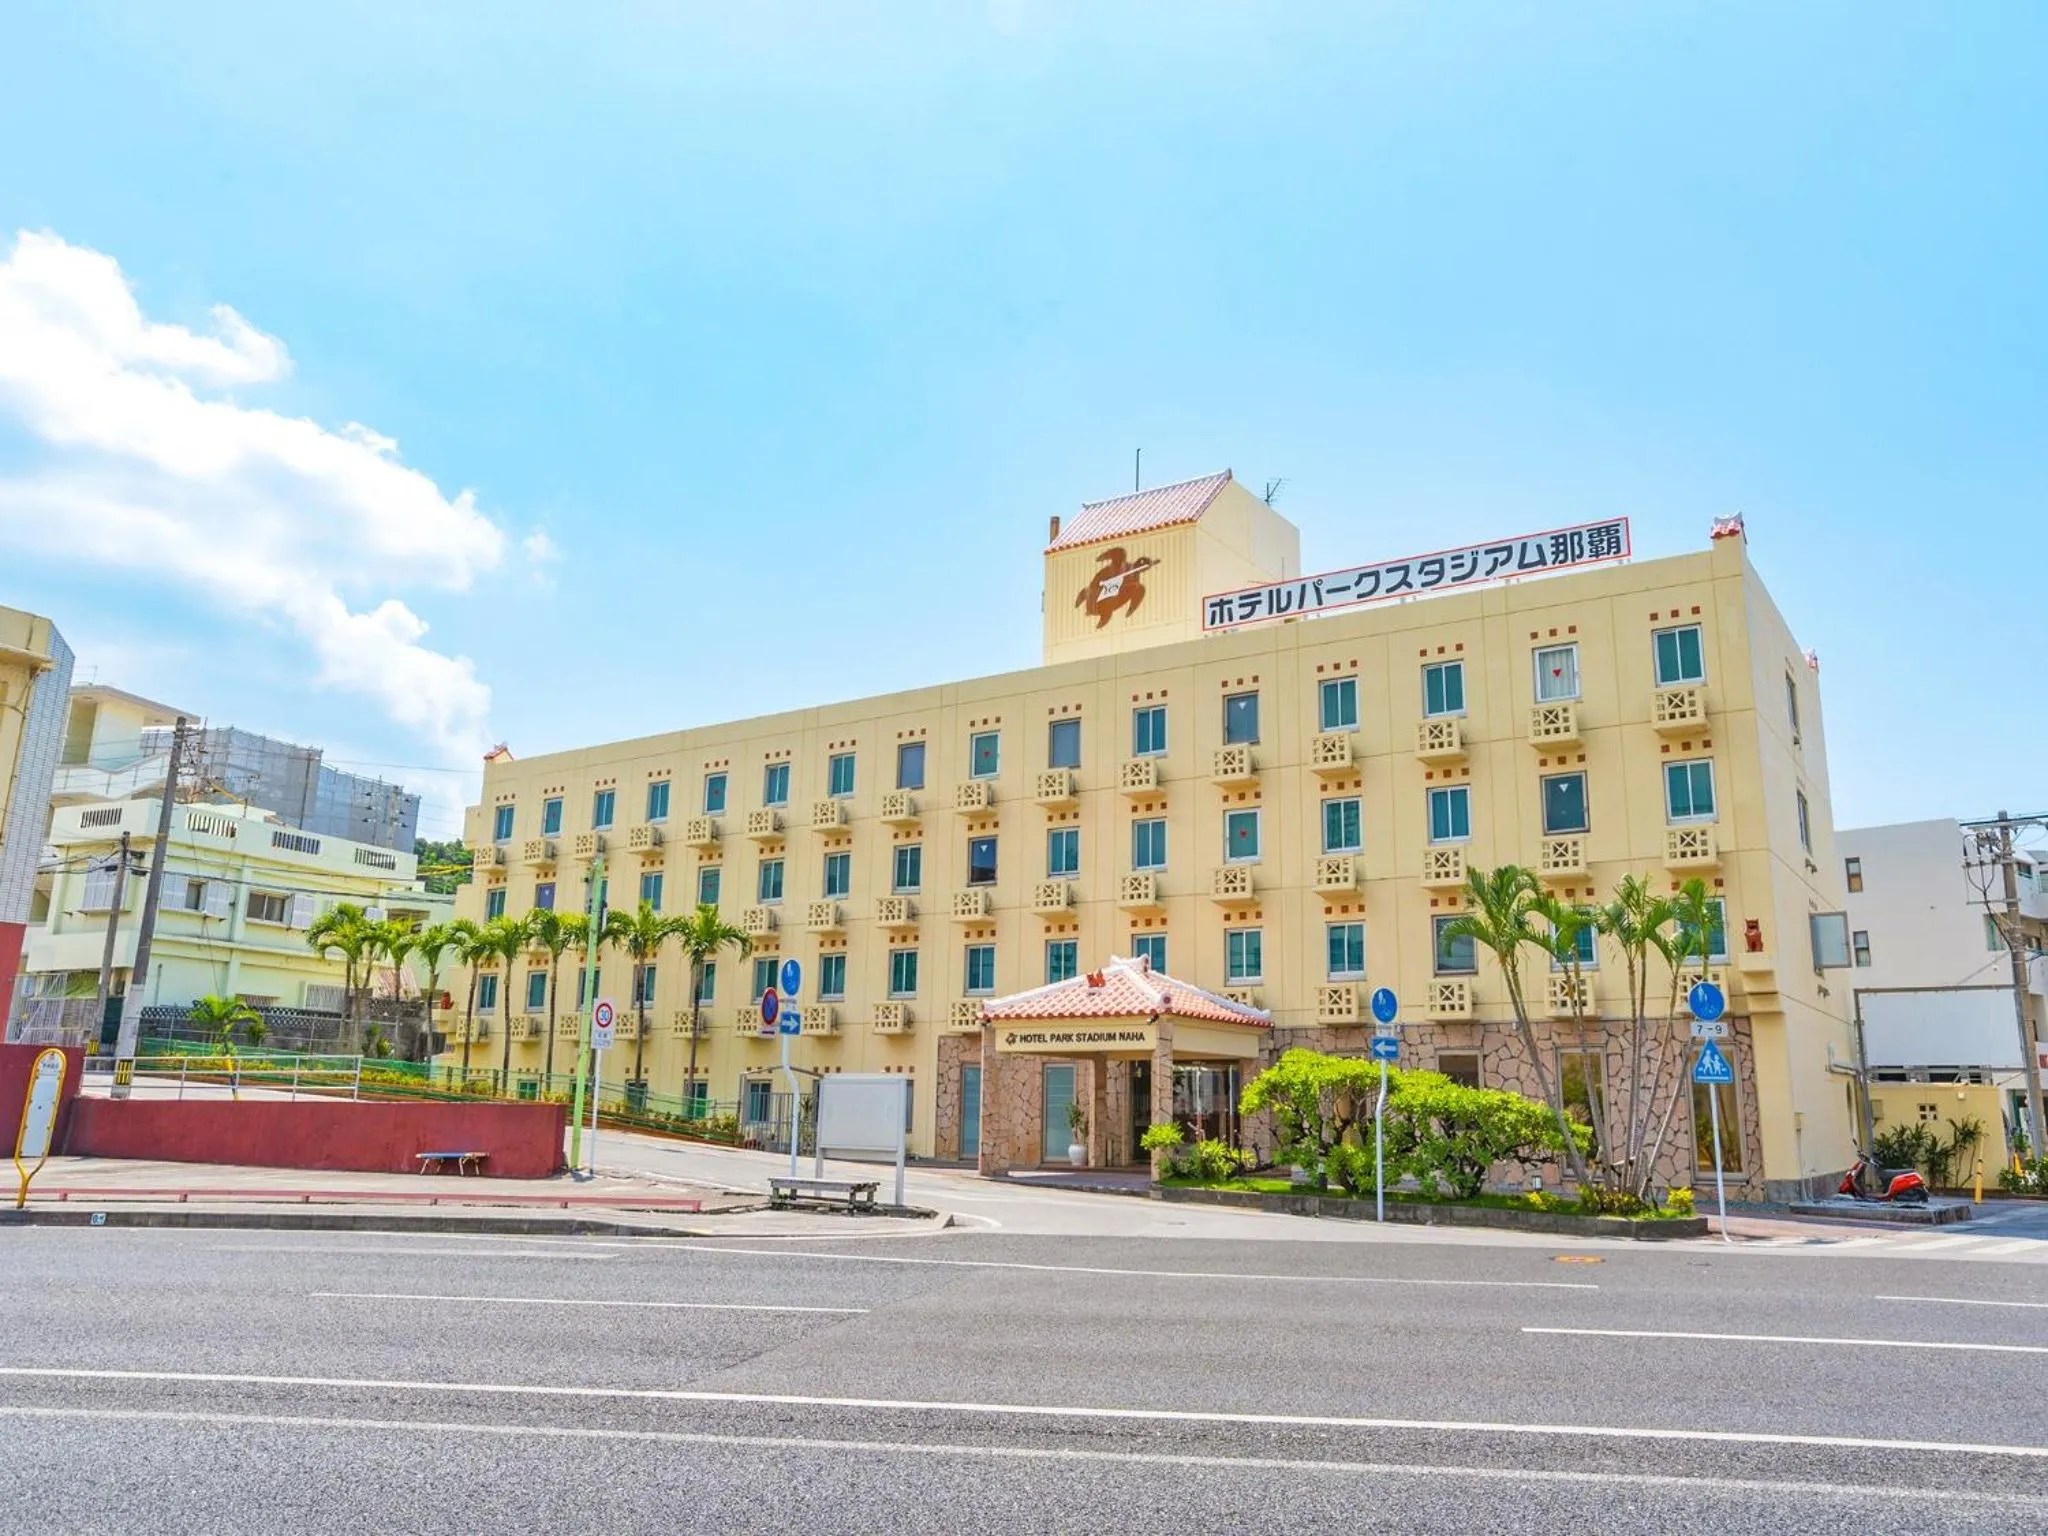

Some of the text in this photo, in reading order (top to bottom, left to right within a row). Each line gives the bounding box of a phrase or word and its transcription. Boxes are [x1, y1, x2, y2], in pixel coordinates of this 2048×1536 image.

[1208, 523, 1622, 626] ホテルパークスタジアム那覇
[599, 1009, 610, 1021] 30
[1019, 1031, 1145, 1044] HOTEL PARK STADIUM NAHA
